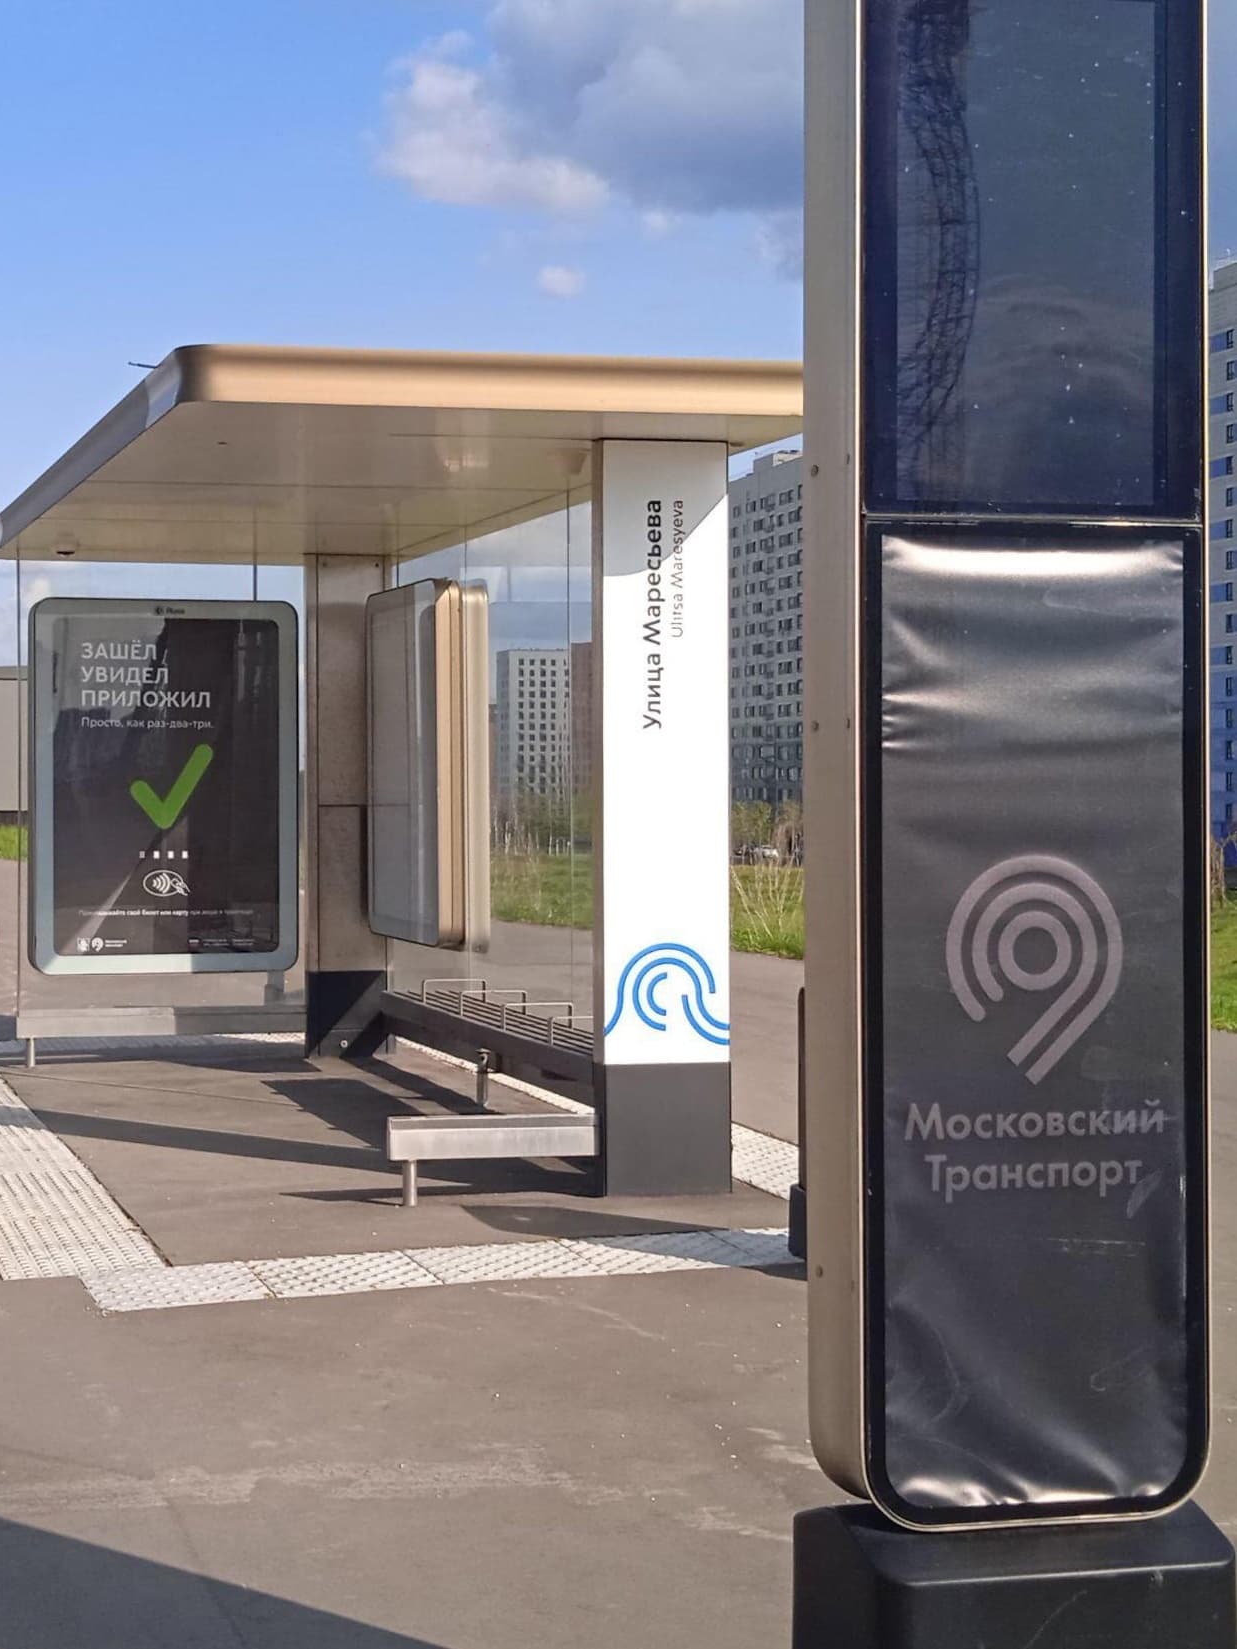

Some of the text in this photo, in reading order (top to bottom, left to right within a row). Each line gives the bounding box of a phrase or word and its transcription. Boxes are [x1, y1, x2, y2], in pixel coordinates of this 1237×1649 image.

[670, 499, 686, 638] Ulitsa Maresyeva
[642, 499, 665, 730] Улица Маресьева
[81, 639, 157, 660] ЗАШЁЛ
[81, 666, 169, 686] УВИДЕЛ
[81, 689, 211, 708] ПРИЛОЖИЛ
[126, 719, 144, 728] как
[904, 1098, 1165, 1141] Московский
[924, 1153, 1143, 1203] Транспорт
